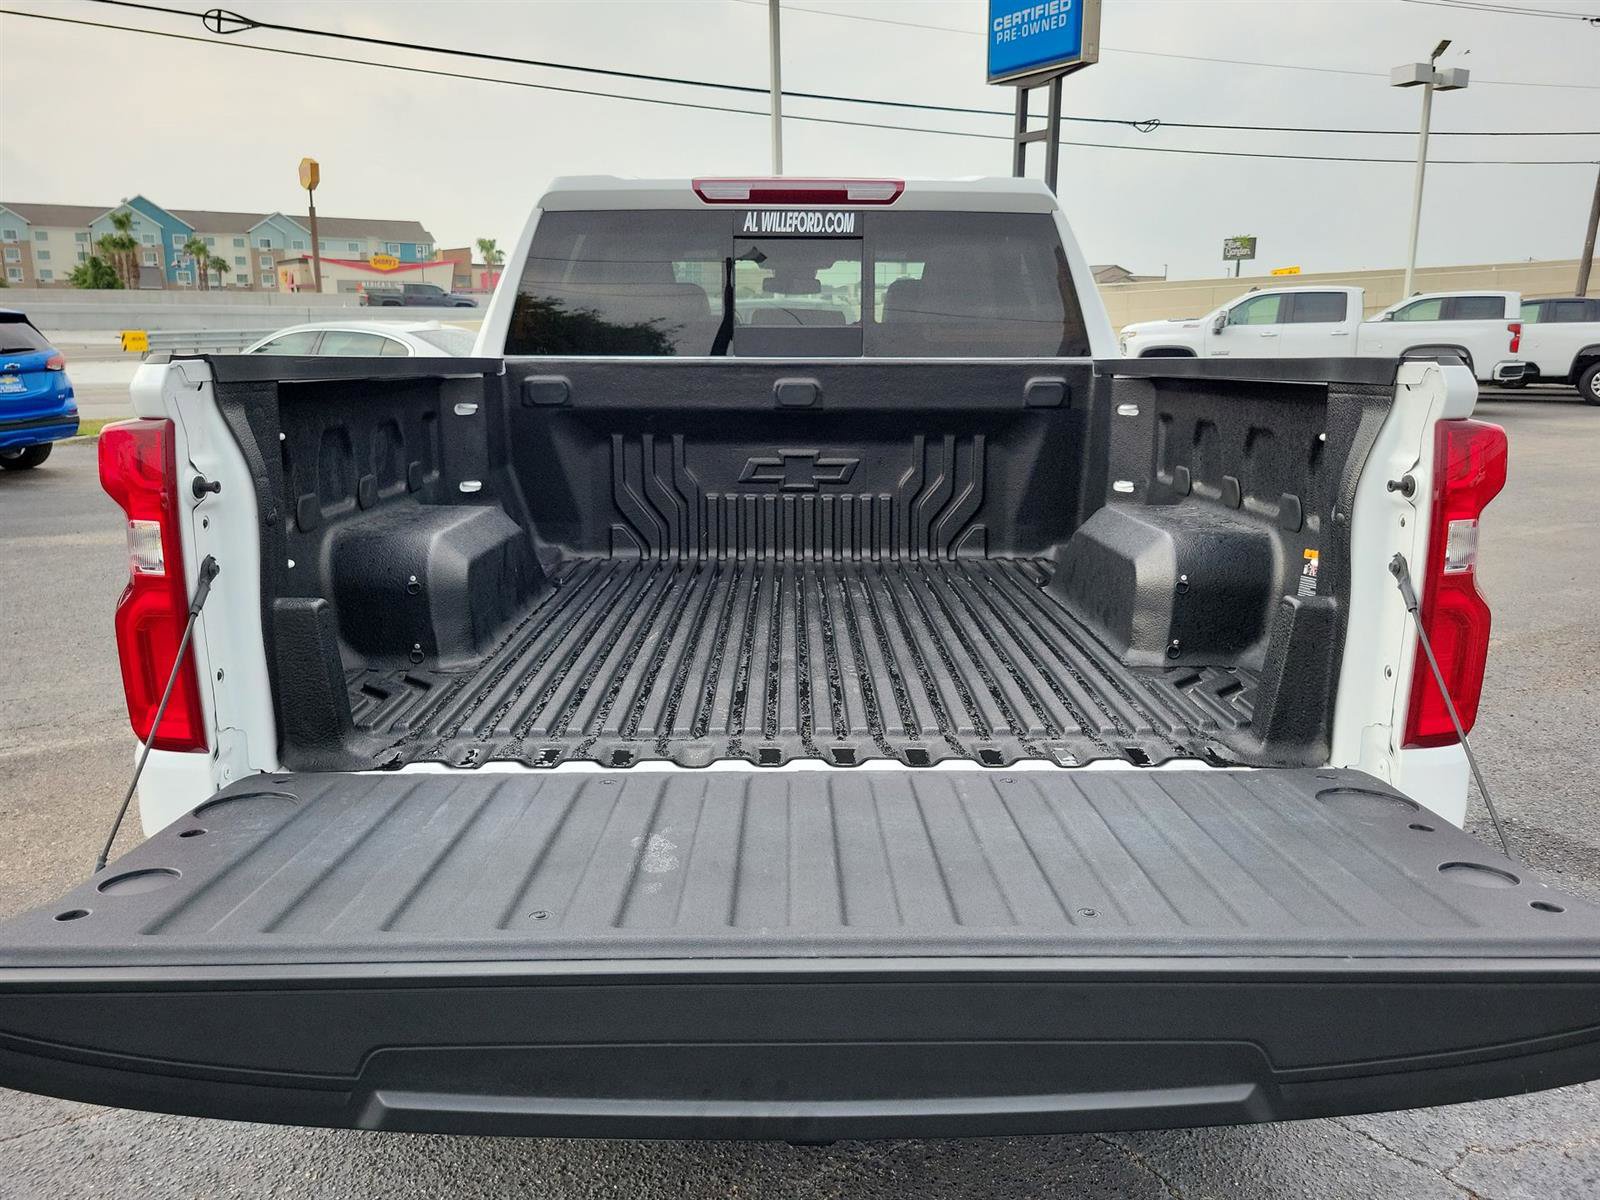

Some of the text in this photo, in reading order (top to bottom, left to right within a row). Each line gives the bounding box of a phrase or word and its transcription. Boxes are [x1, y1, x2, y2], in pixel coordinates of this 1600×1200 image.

[993, 0, 1072, 32] CERTIFIED
[996, 14, 1067, 45] PRE-OWNED
[743, 211, 855, 233] AL WILLEFORD.COM
